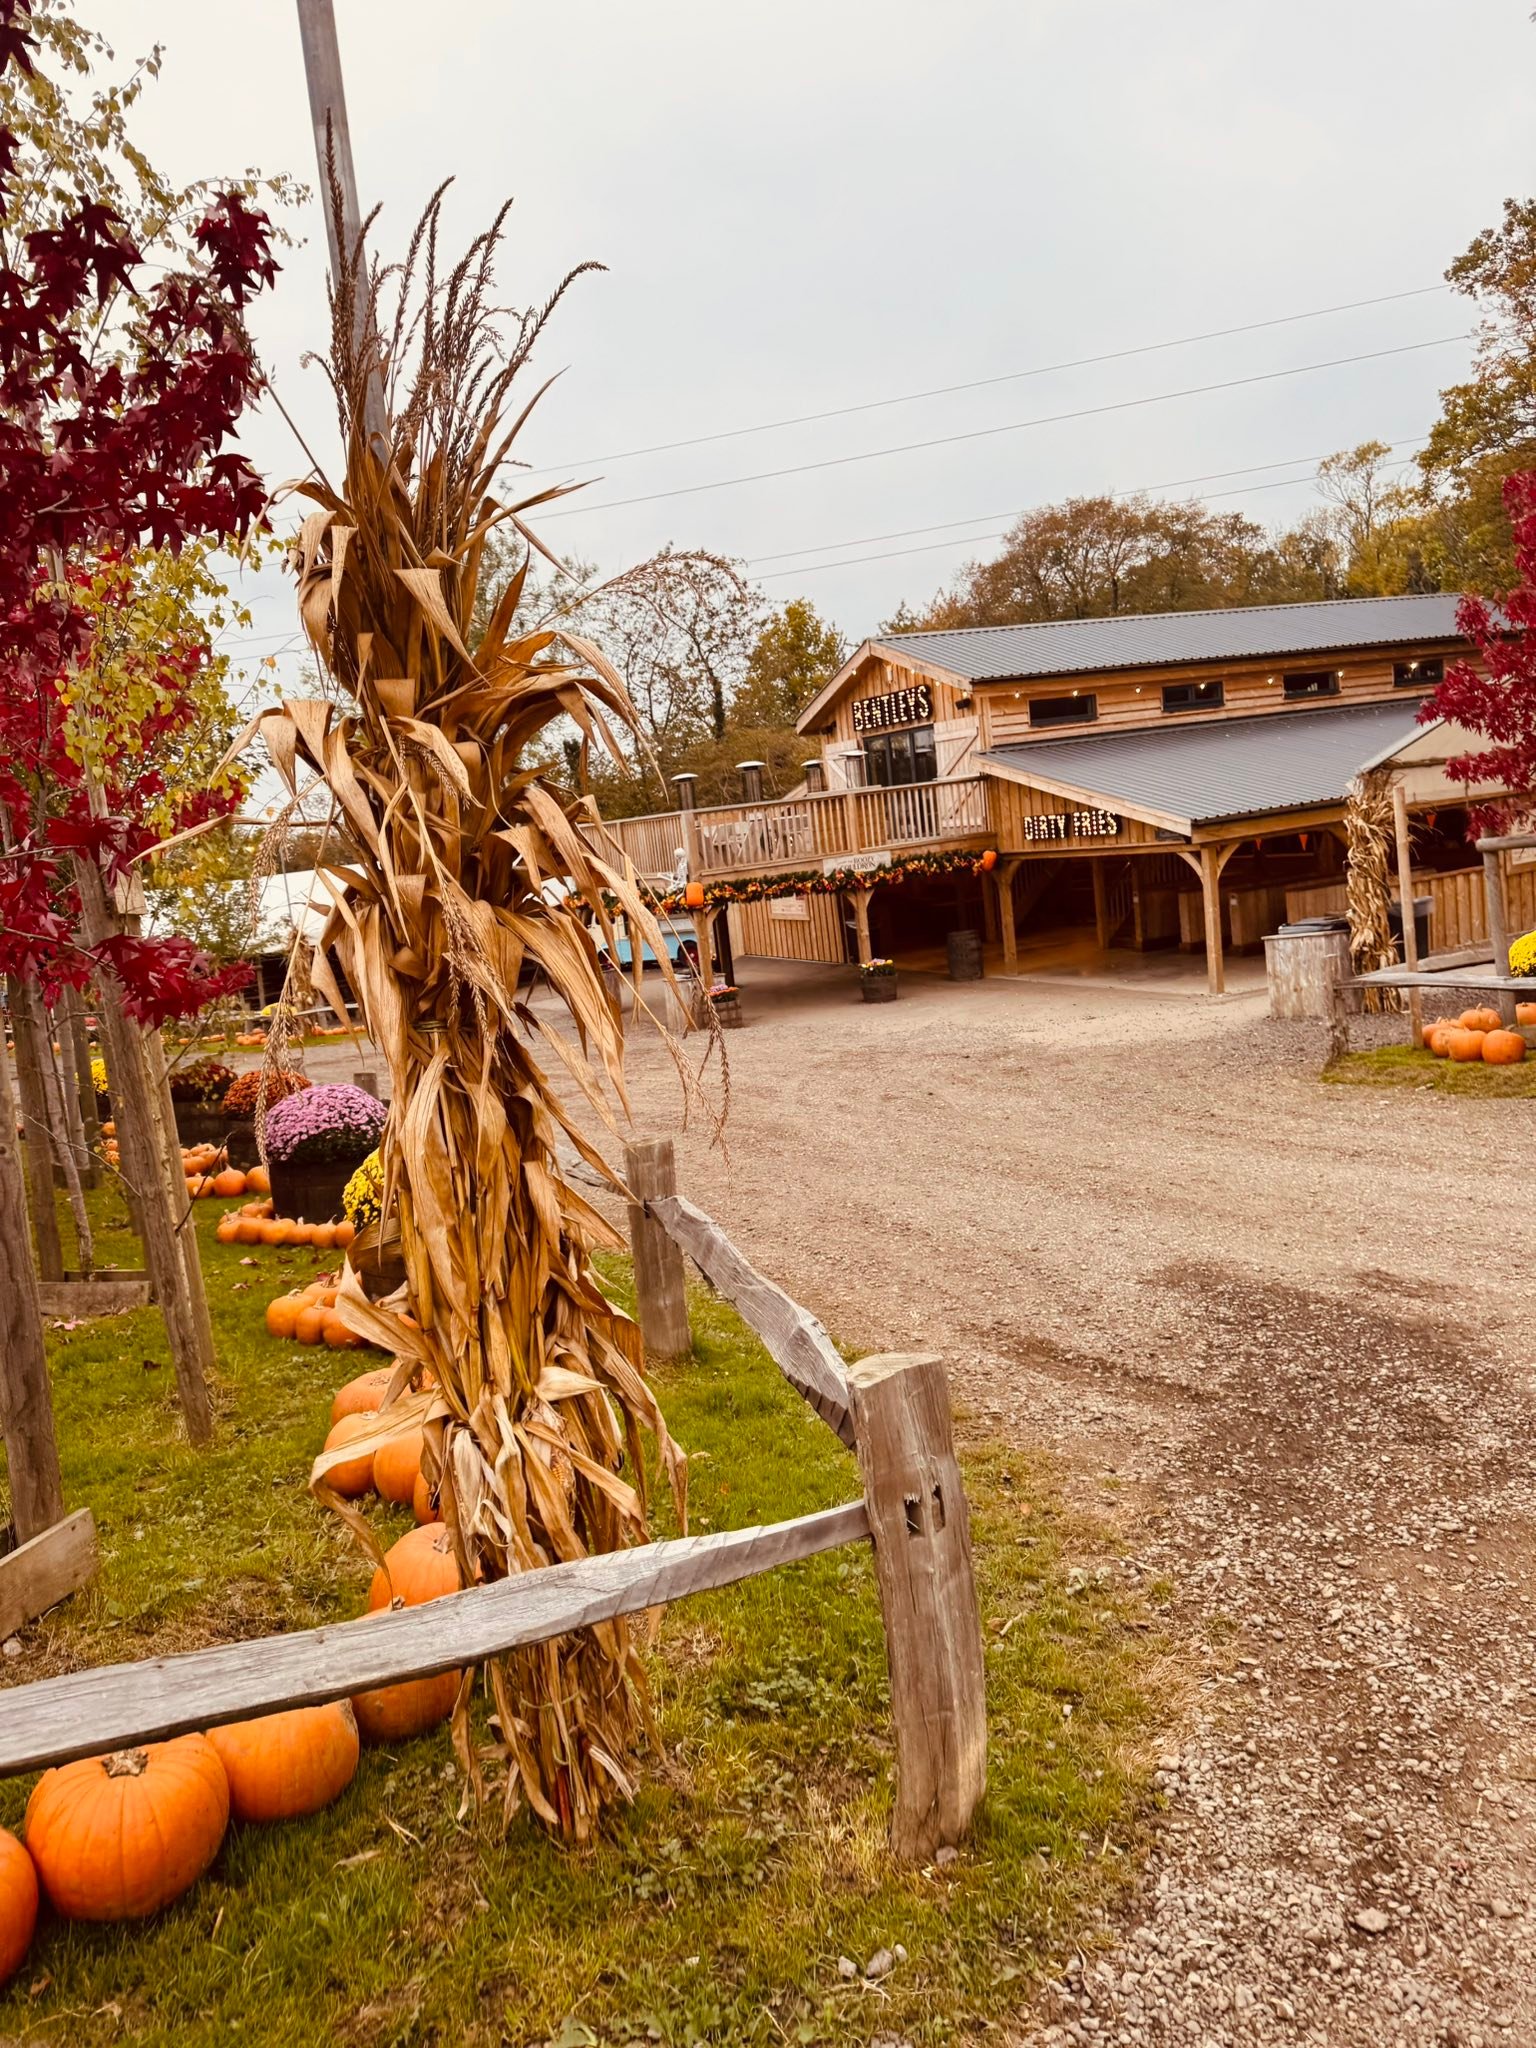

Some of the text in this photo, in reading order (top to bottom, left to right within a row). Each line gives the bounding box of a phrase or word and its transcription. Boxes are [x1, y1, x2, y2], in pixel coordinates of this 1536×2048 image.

[853, 685, 929, 731] BENTLEYS
[1024, 809, 1119, 841] DIRTY FRIES
